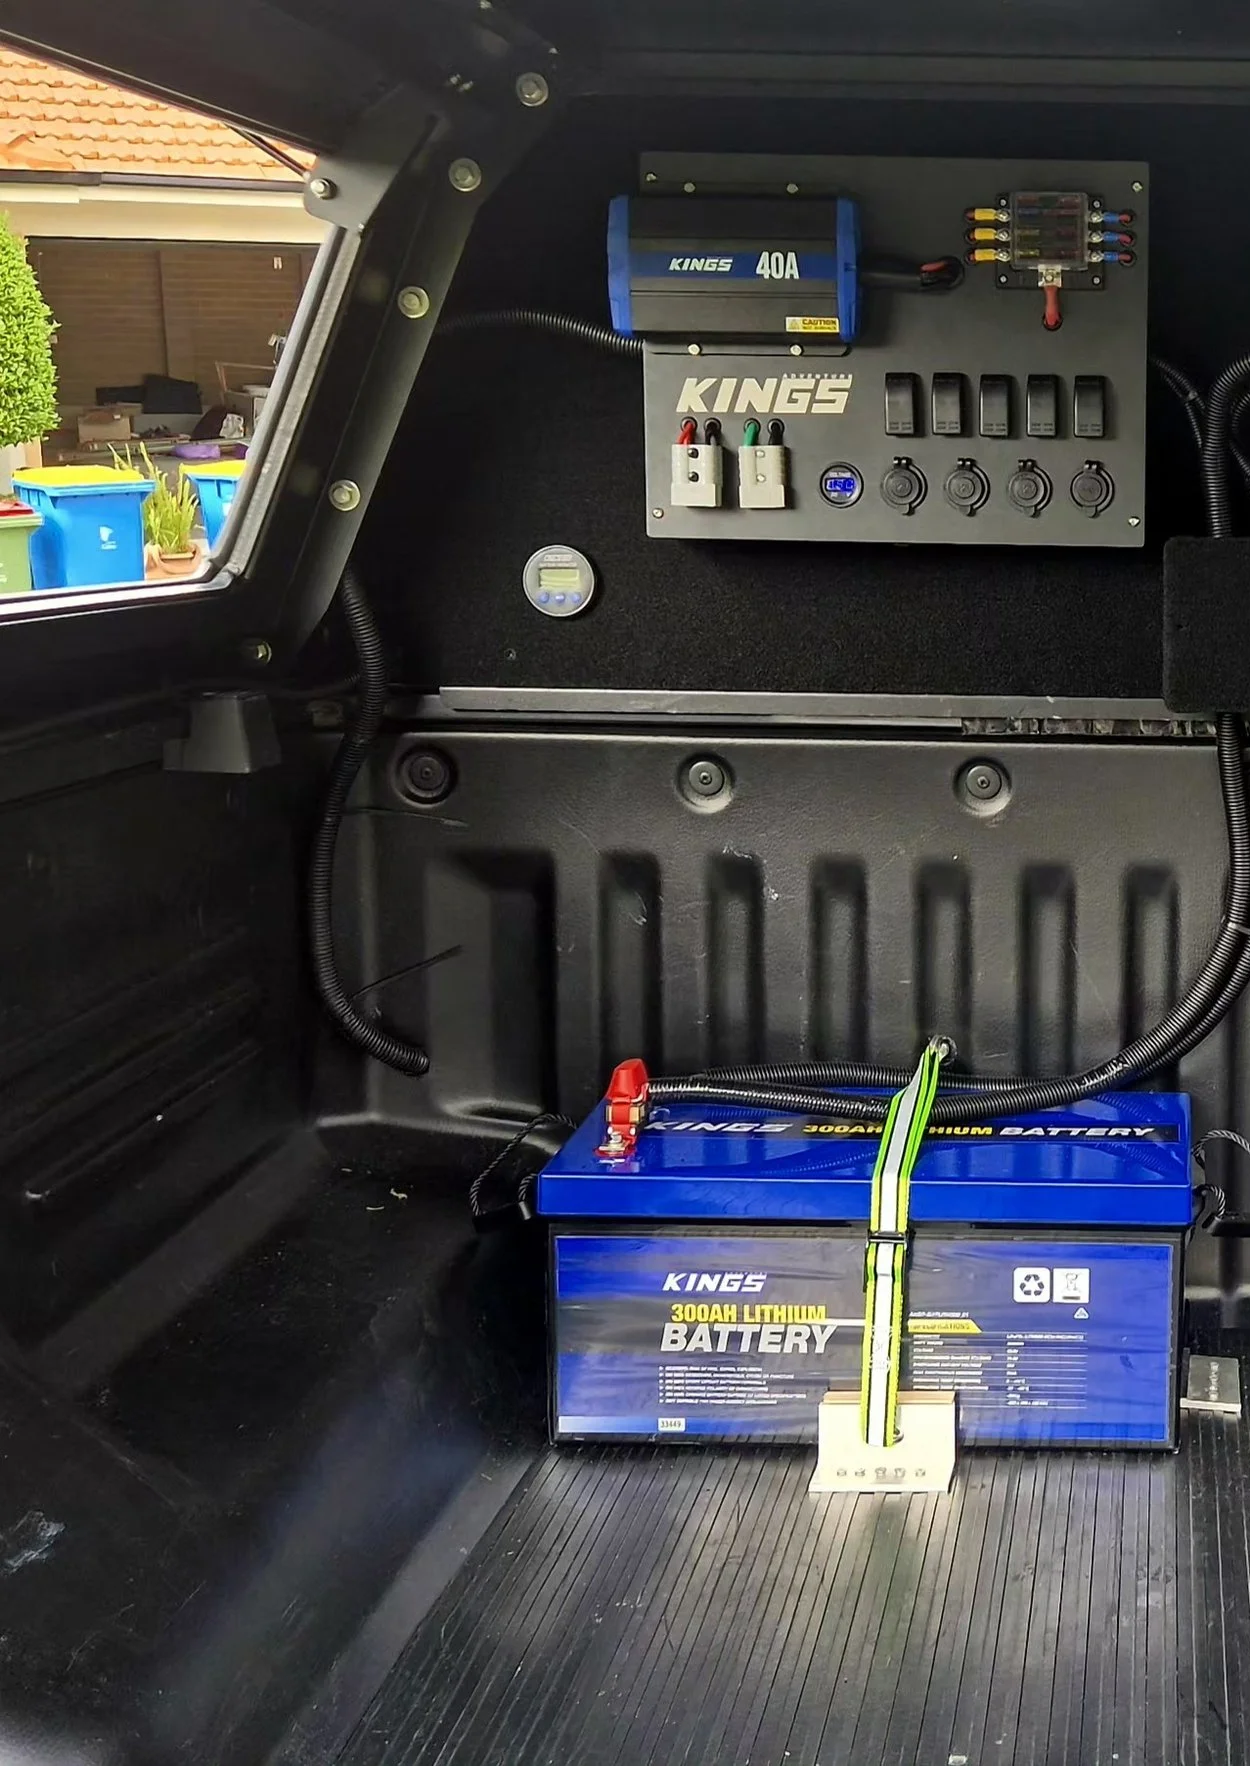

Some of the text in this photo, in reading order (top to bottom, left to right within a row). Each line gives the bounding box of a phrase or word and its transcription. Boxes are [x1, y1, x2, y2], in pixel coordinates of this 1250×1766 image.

[668, 251, 800, 280] KINGS 40A
[675, 377, 853, 414] KINGS
[644, 1121, 794, 1133] KINGS
[803, 1124, 883, 1135] 300AH
[999, 1127, 1155, 1136] BATTERY
[662, 1272, 768, 1293] KINGS
[671, 1303, 827, 1324] 300AH LITHIUM
[660, 1322, 839, 1354] BATTERY
